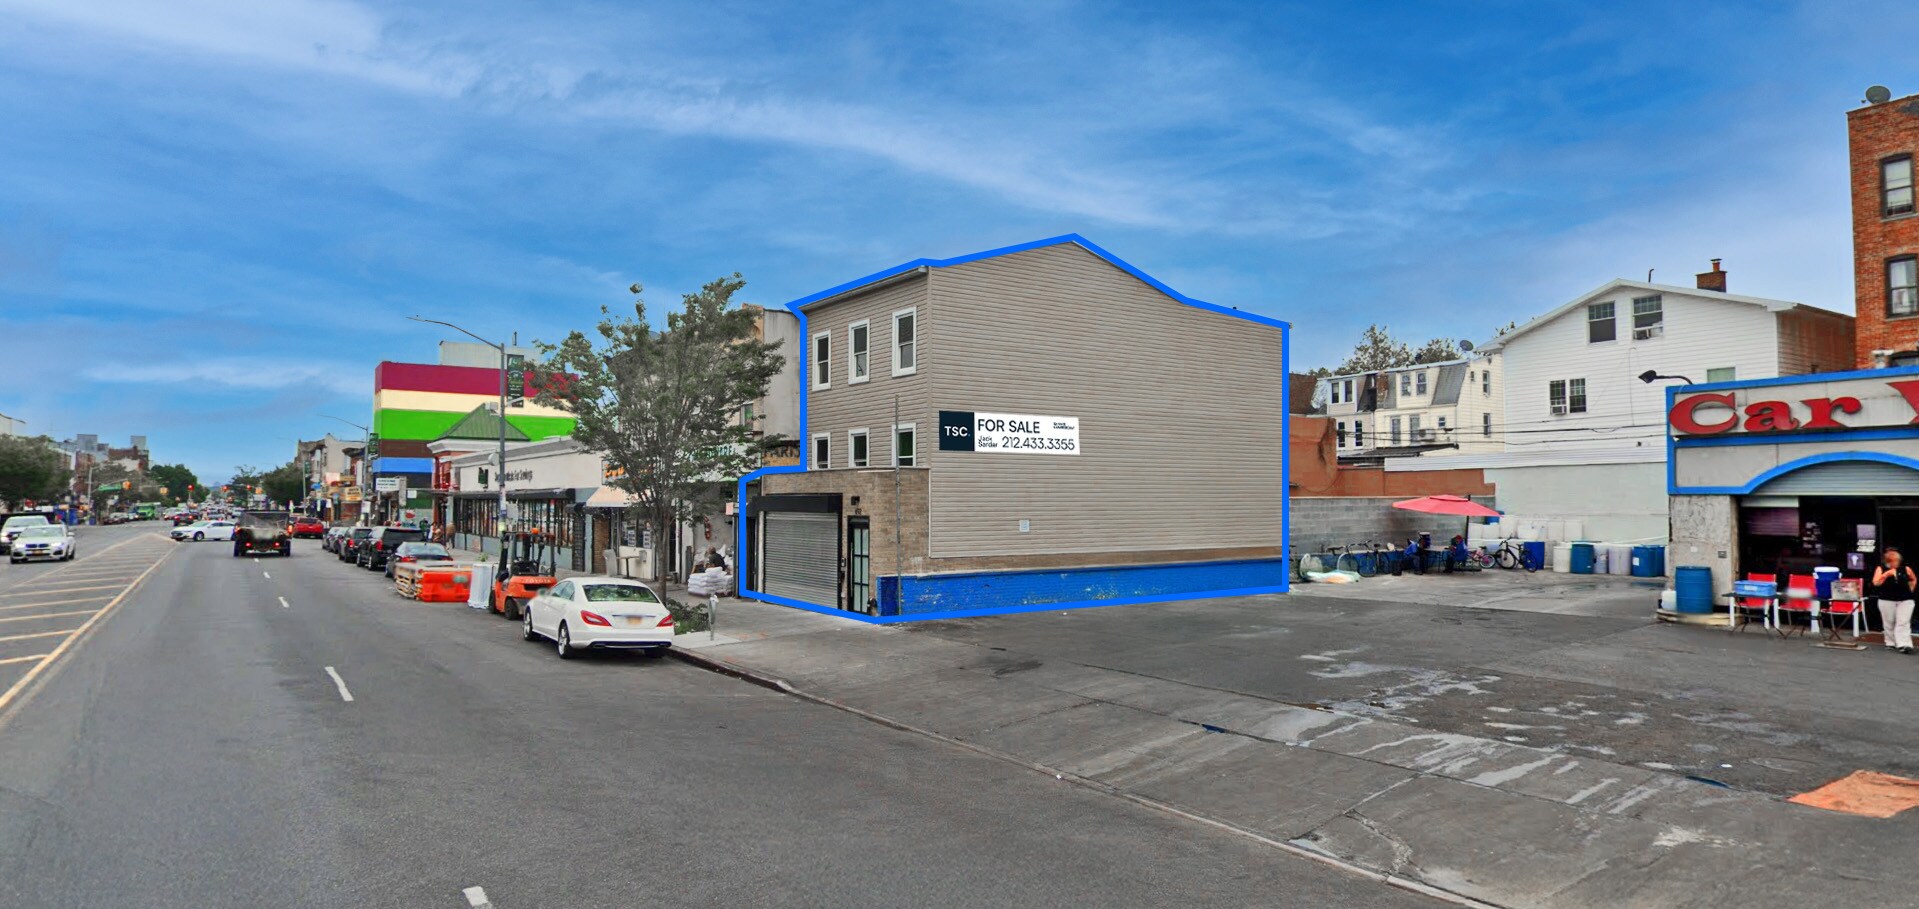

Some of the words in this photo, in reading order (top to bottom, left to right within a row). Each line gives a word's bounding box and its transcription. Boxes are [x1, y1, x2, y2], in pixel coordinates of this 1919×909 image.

[1669, 392, 1862, 435] Car
[977, 419, 1005, 432] FOR
[1009, 420, 1040, 434] SALE
[1001, 435, 1075, 450] 212.433.3355
